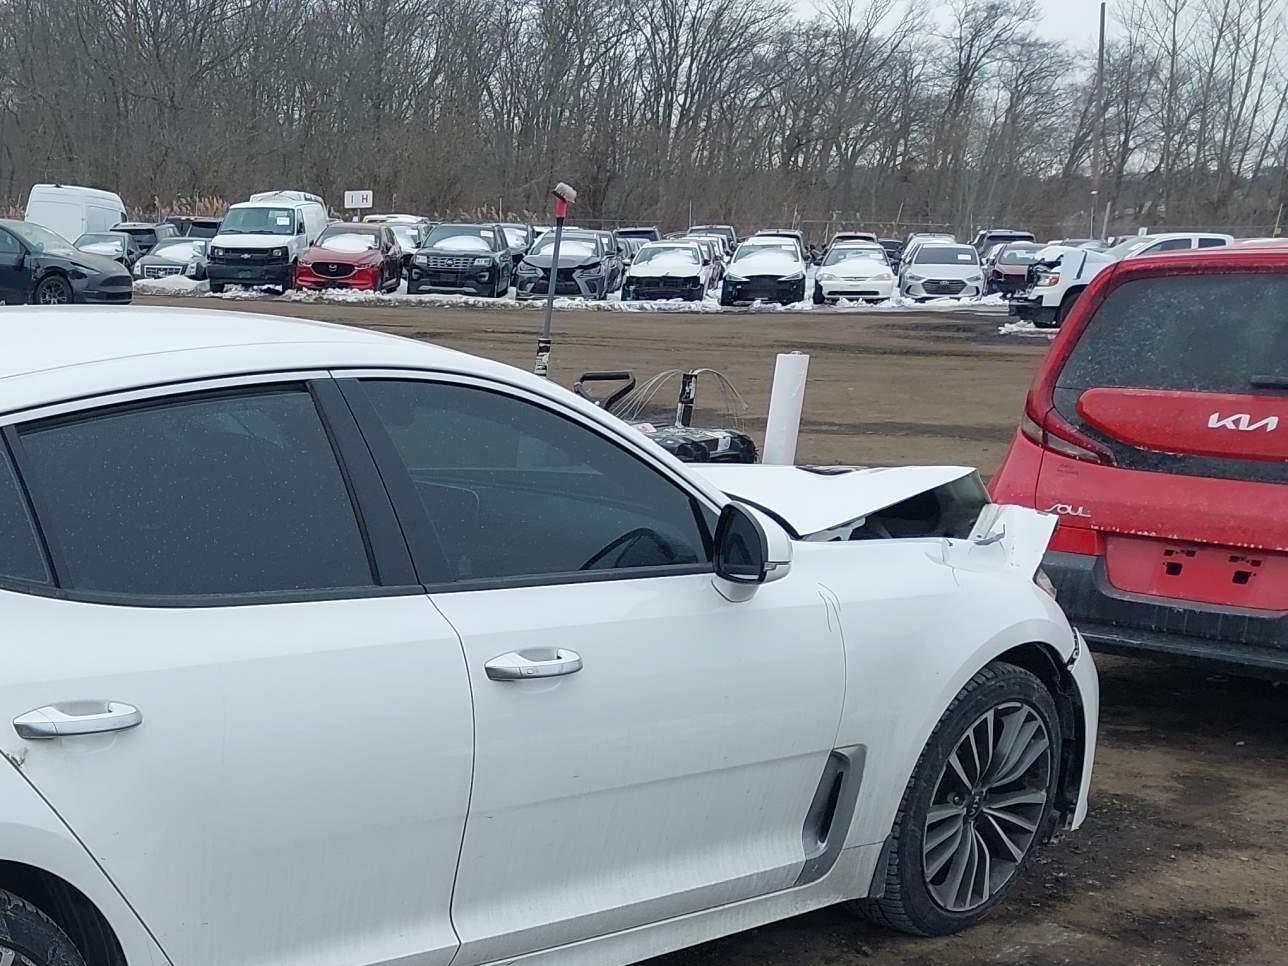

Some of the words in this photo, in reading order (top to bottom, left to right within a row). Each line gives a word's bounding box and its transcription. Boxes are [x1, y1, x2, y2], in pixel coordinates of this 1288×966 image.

[361, 194, 369, 204] H
[1207, 412, 1279, 432] KIA
[1044, 503, 1091, 518] SOUL
